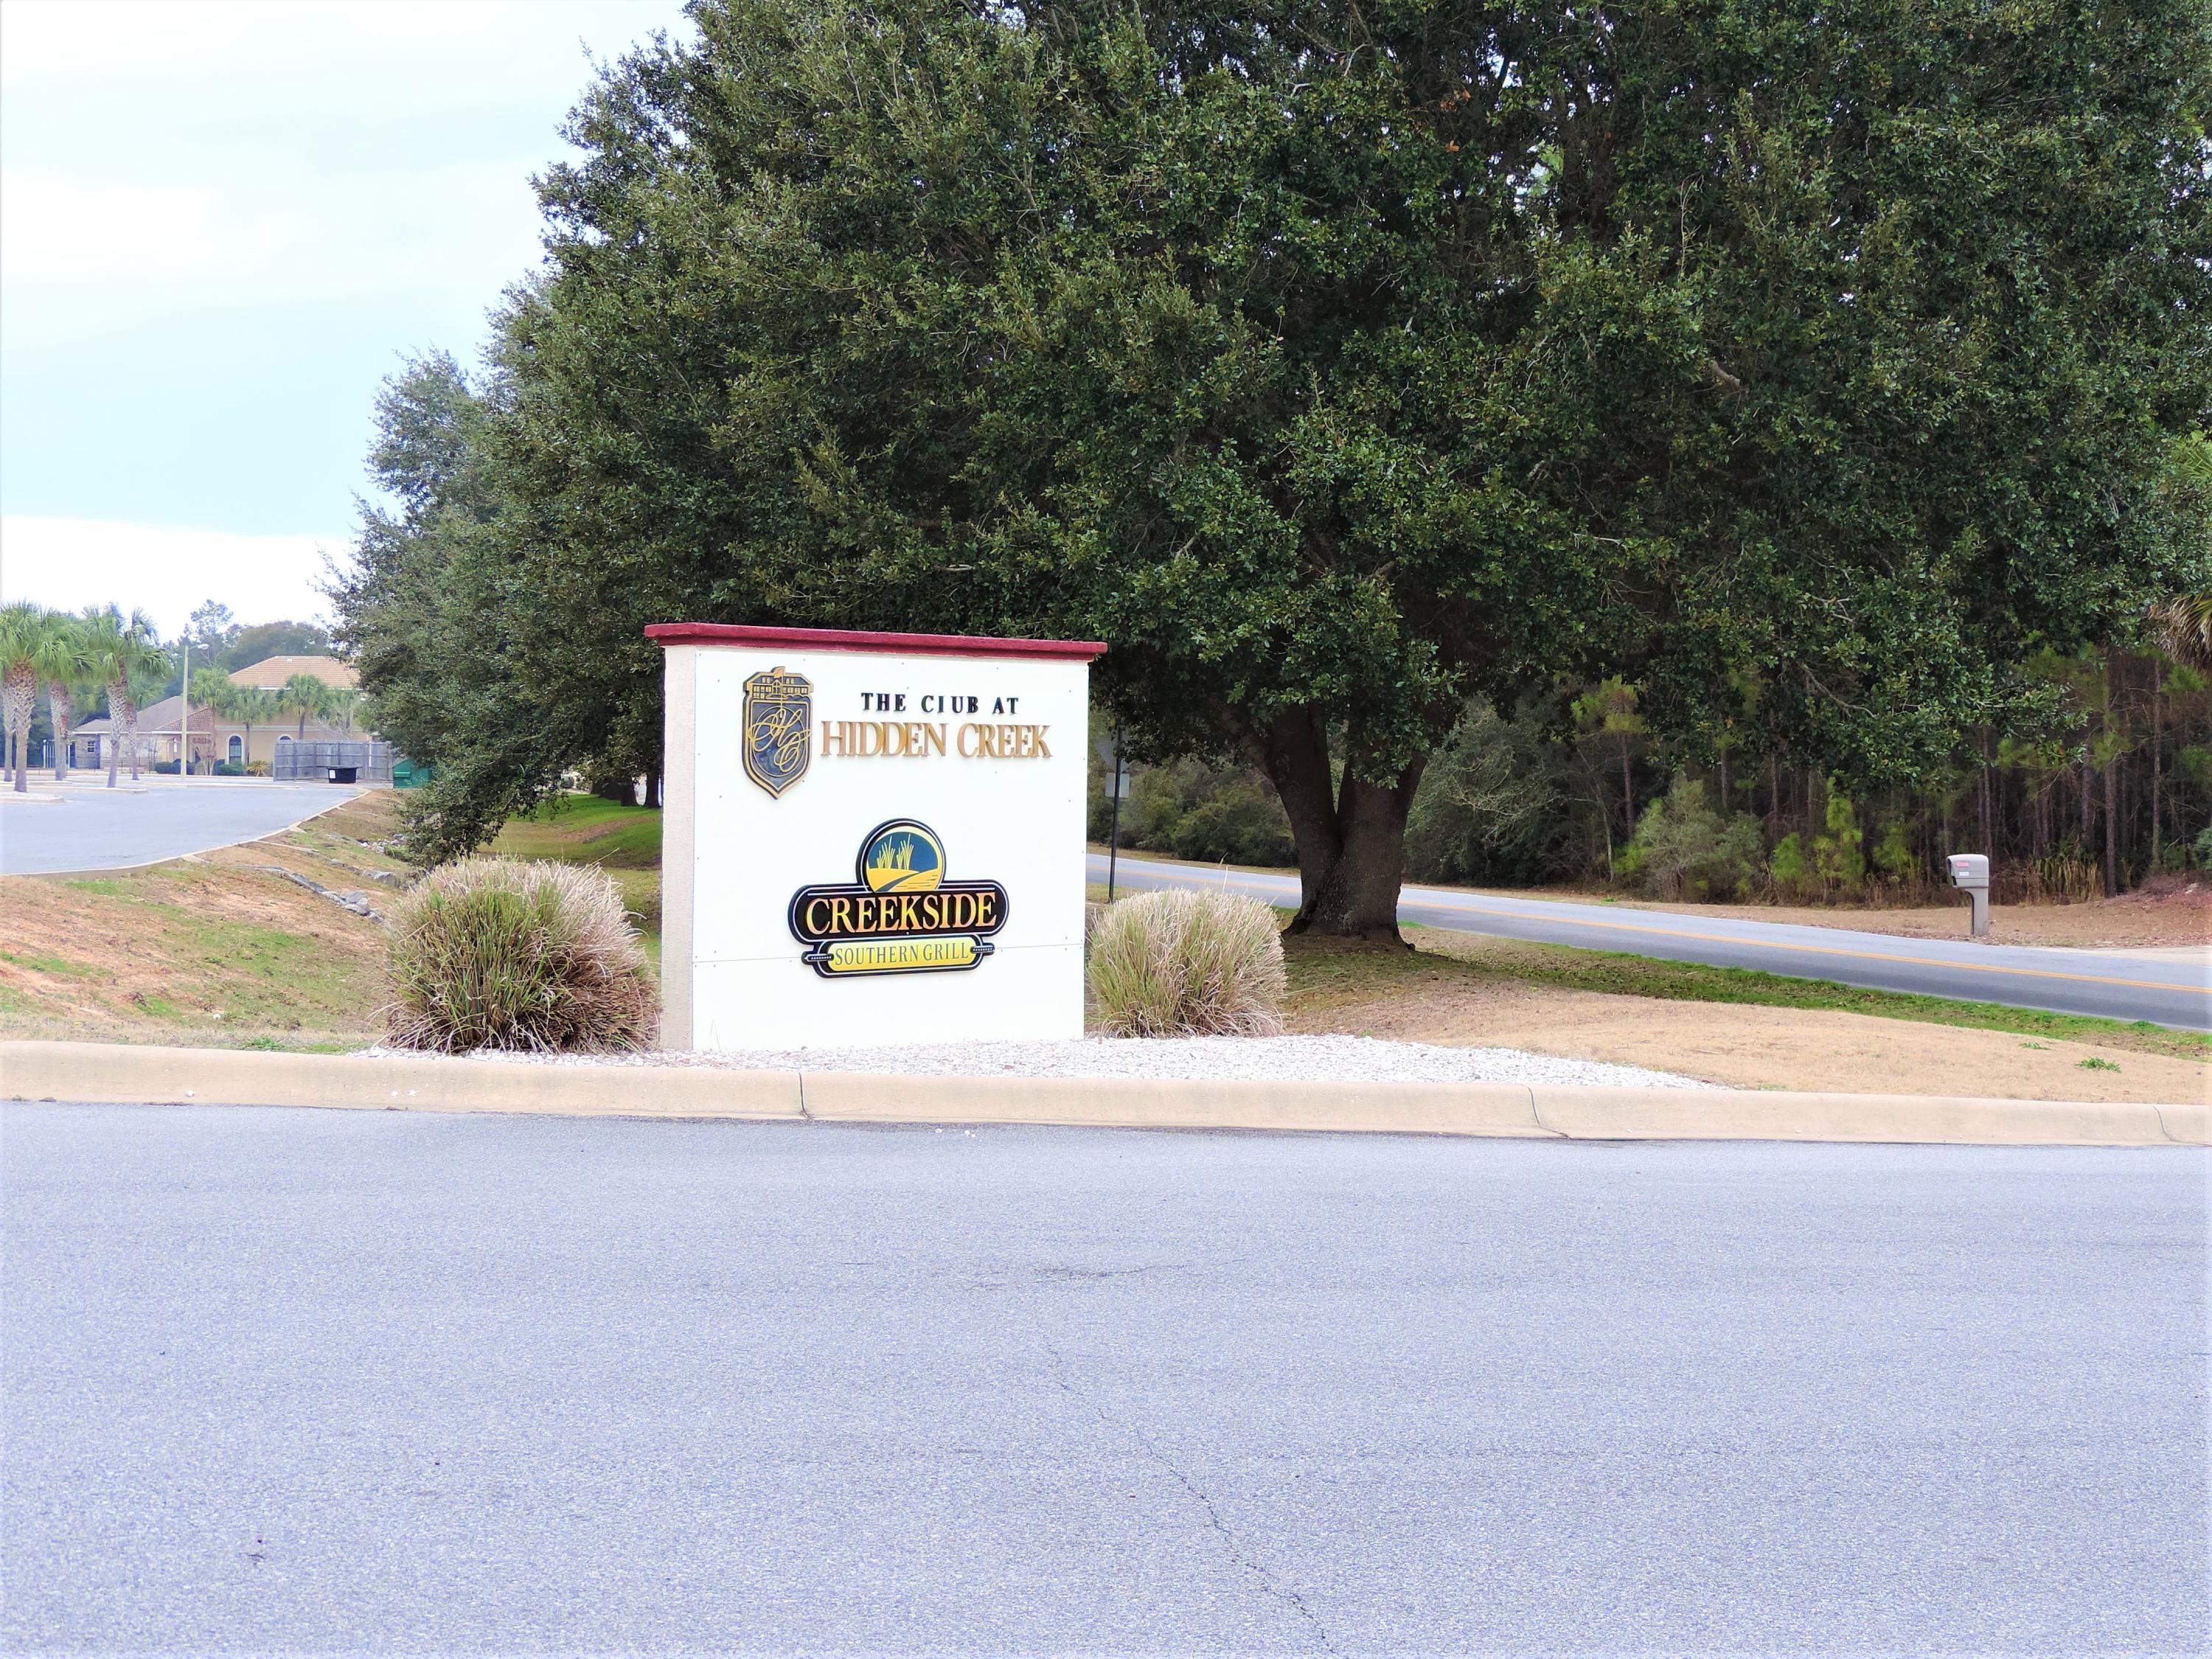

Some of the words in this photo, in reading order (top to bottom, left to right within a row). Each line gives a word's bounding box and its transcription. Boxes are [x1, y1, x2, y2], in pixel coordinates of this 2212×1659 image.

[860, 692, 906, 712] THE
[992, 698, 1019, 714] AT
[820, 720, 949, 757] HIDDEN
[957, 723, 1053, 758] CREEK
[806, 892, 998, 935] CREEKSIDE
[835, 945, 919, 965] SOUTHERN
[922, 942, 970, 961] GRILL
